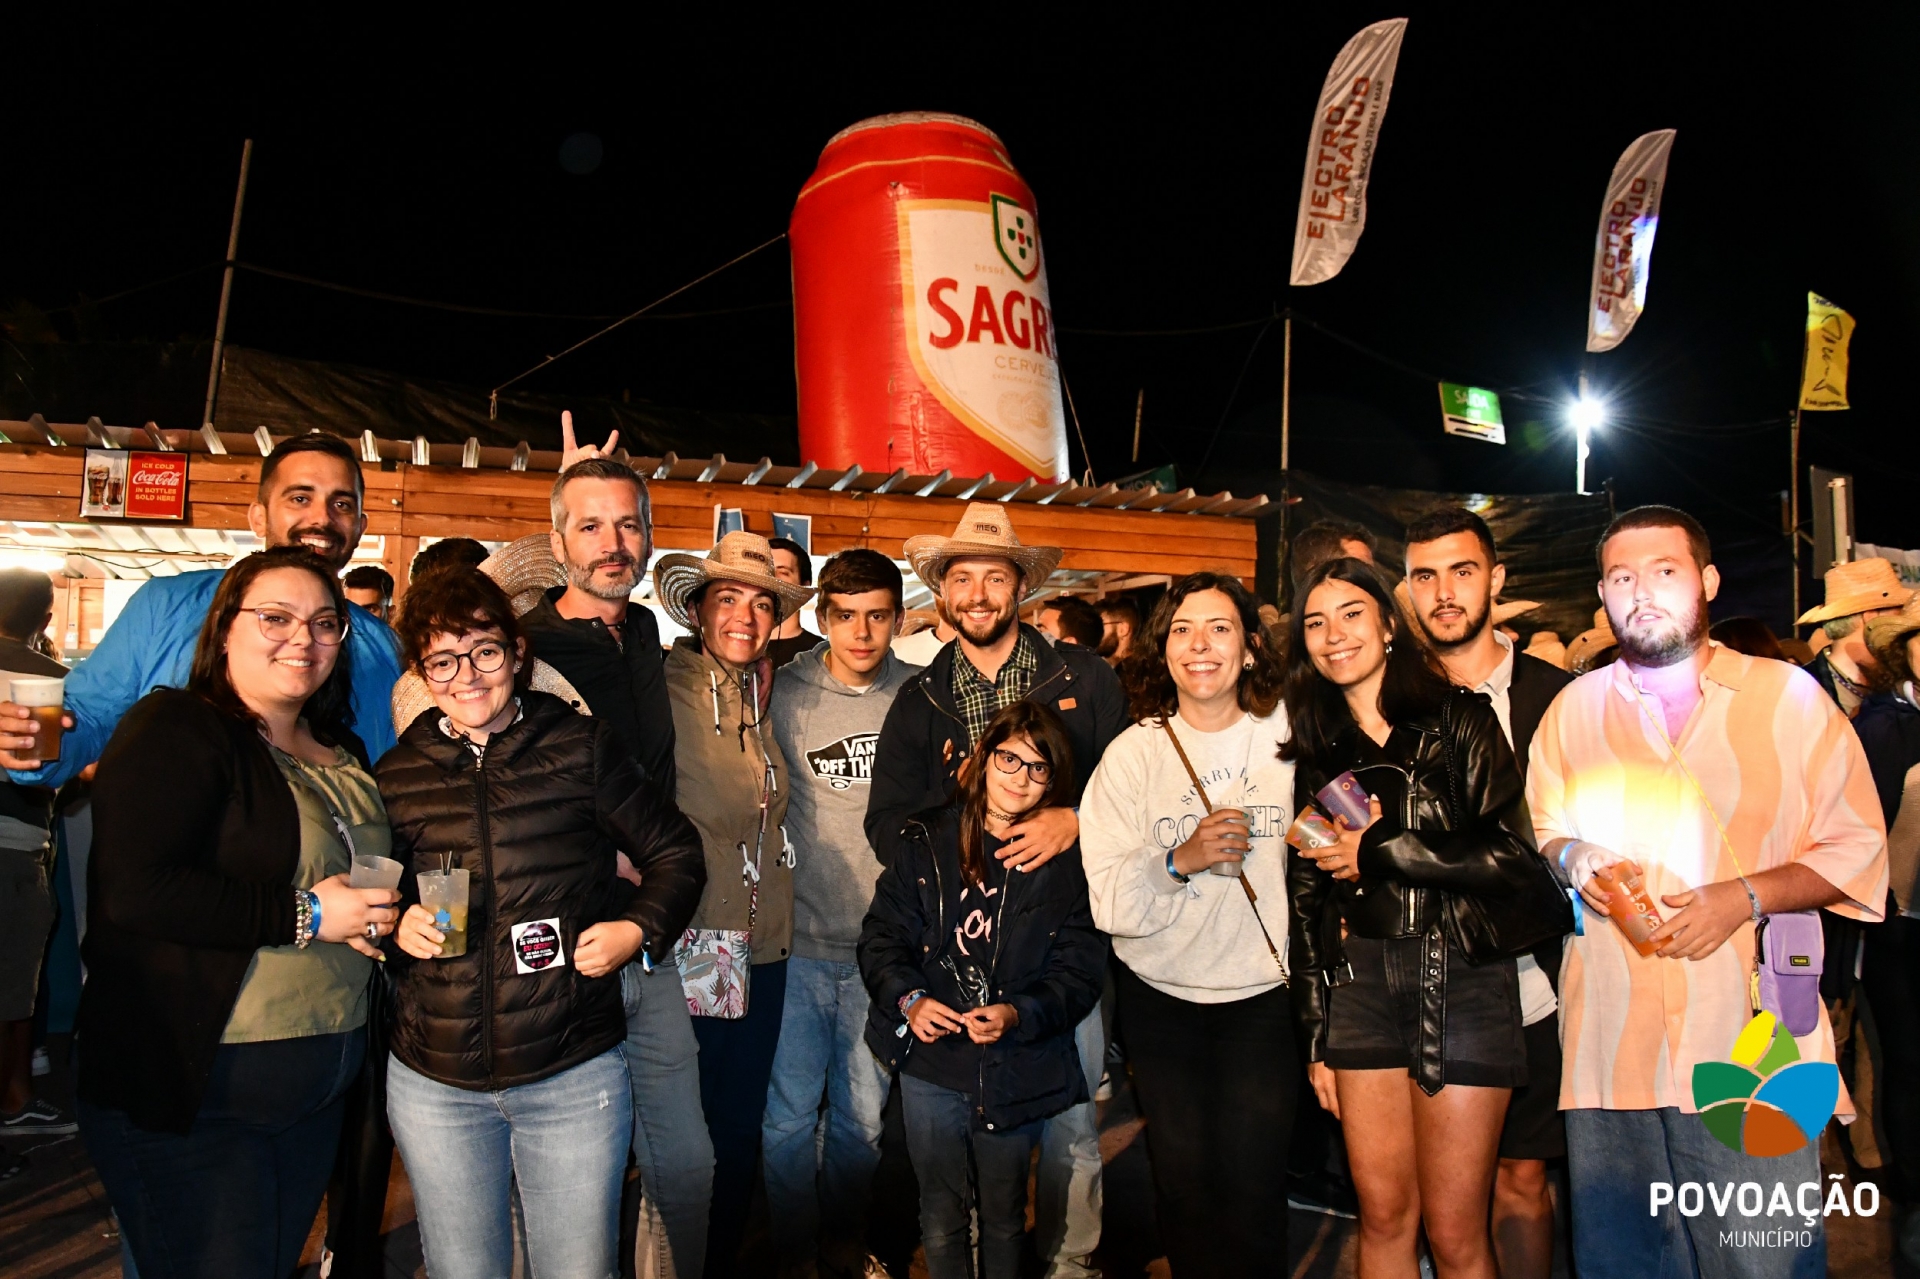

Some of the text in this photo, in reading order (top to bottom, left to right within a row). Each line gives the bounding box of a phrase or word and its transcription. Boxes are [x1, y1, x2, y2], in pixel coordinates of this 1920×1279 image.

[1322, 76, 1371, 221] LARANJO
[1611, 177, 1647, 299] LARANJO
[144, 487, 177, 495] BOTTLES
[976, 524, 998, 533] MEO
[744, 551, 766, 562] MEO
[842, 735, 878, 758] VAN
[1181, 767, 1233, 805] SORRY
